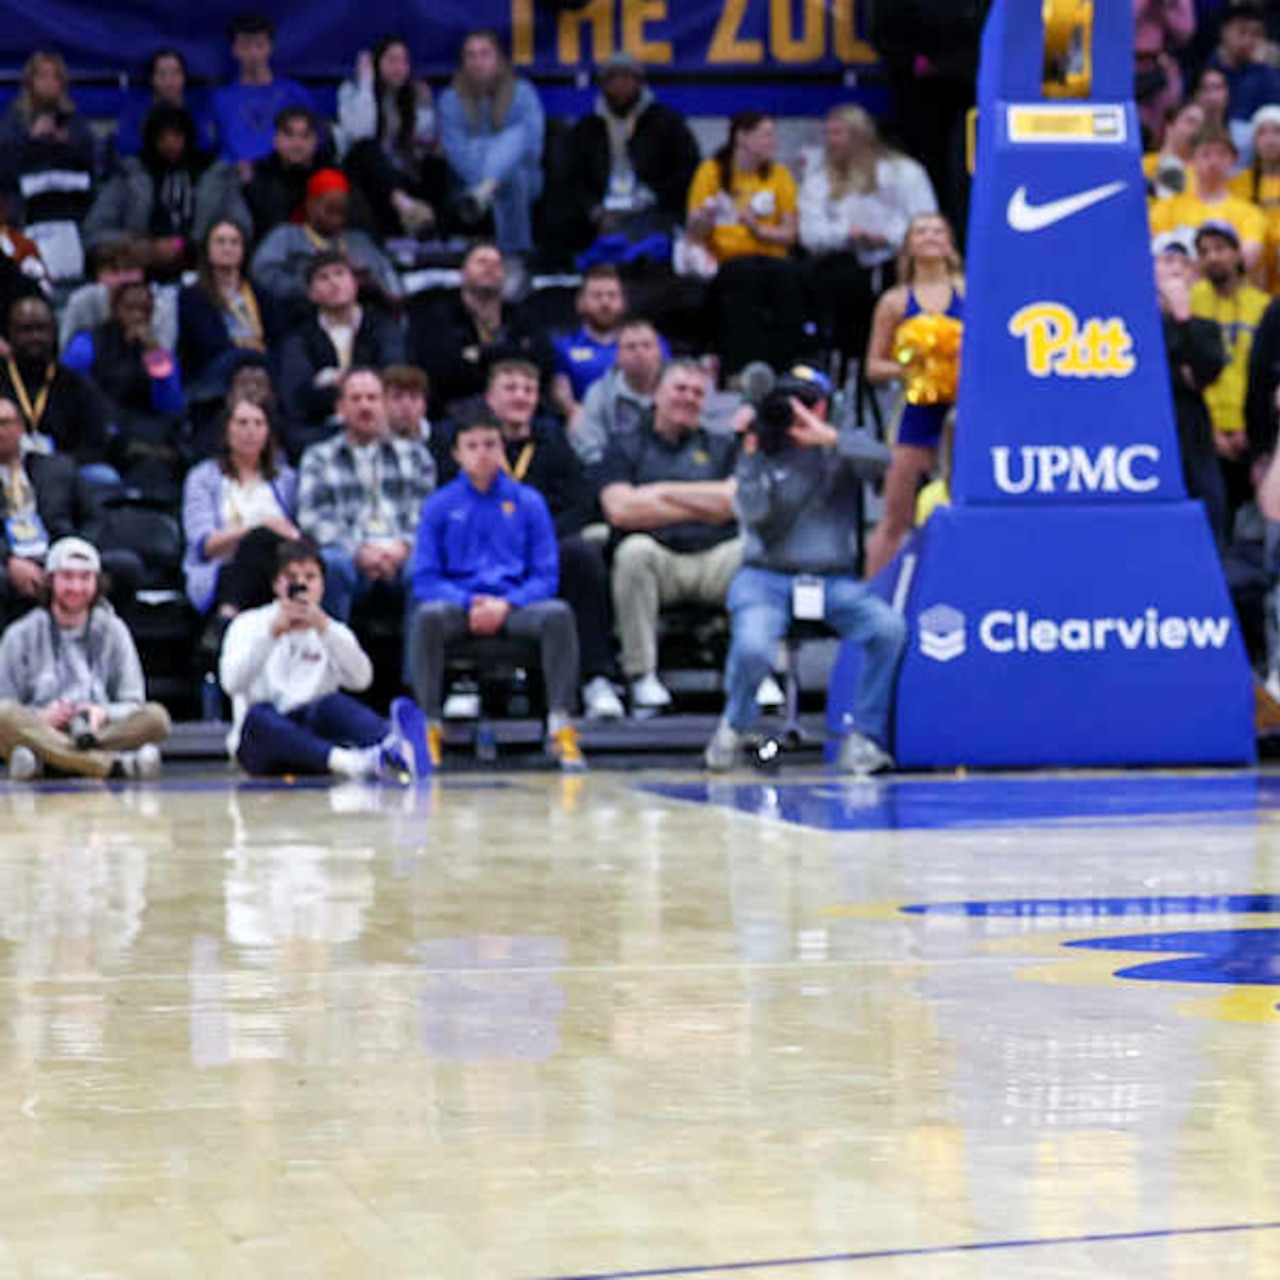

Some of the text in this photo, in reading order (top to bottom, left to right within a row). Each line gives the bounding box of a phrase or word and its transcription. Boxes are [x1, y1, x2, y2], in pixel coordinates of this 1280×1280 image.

[1008, 301, 1136, 379] Pitt
[990, 444, 1160, 494] UPMC
[979, 607, 1231, 653] Clearview
